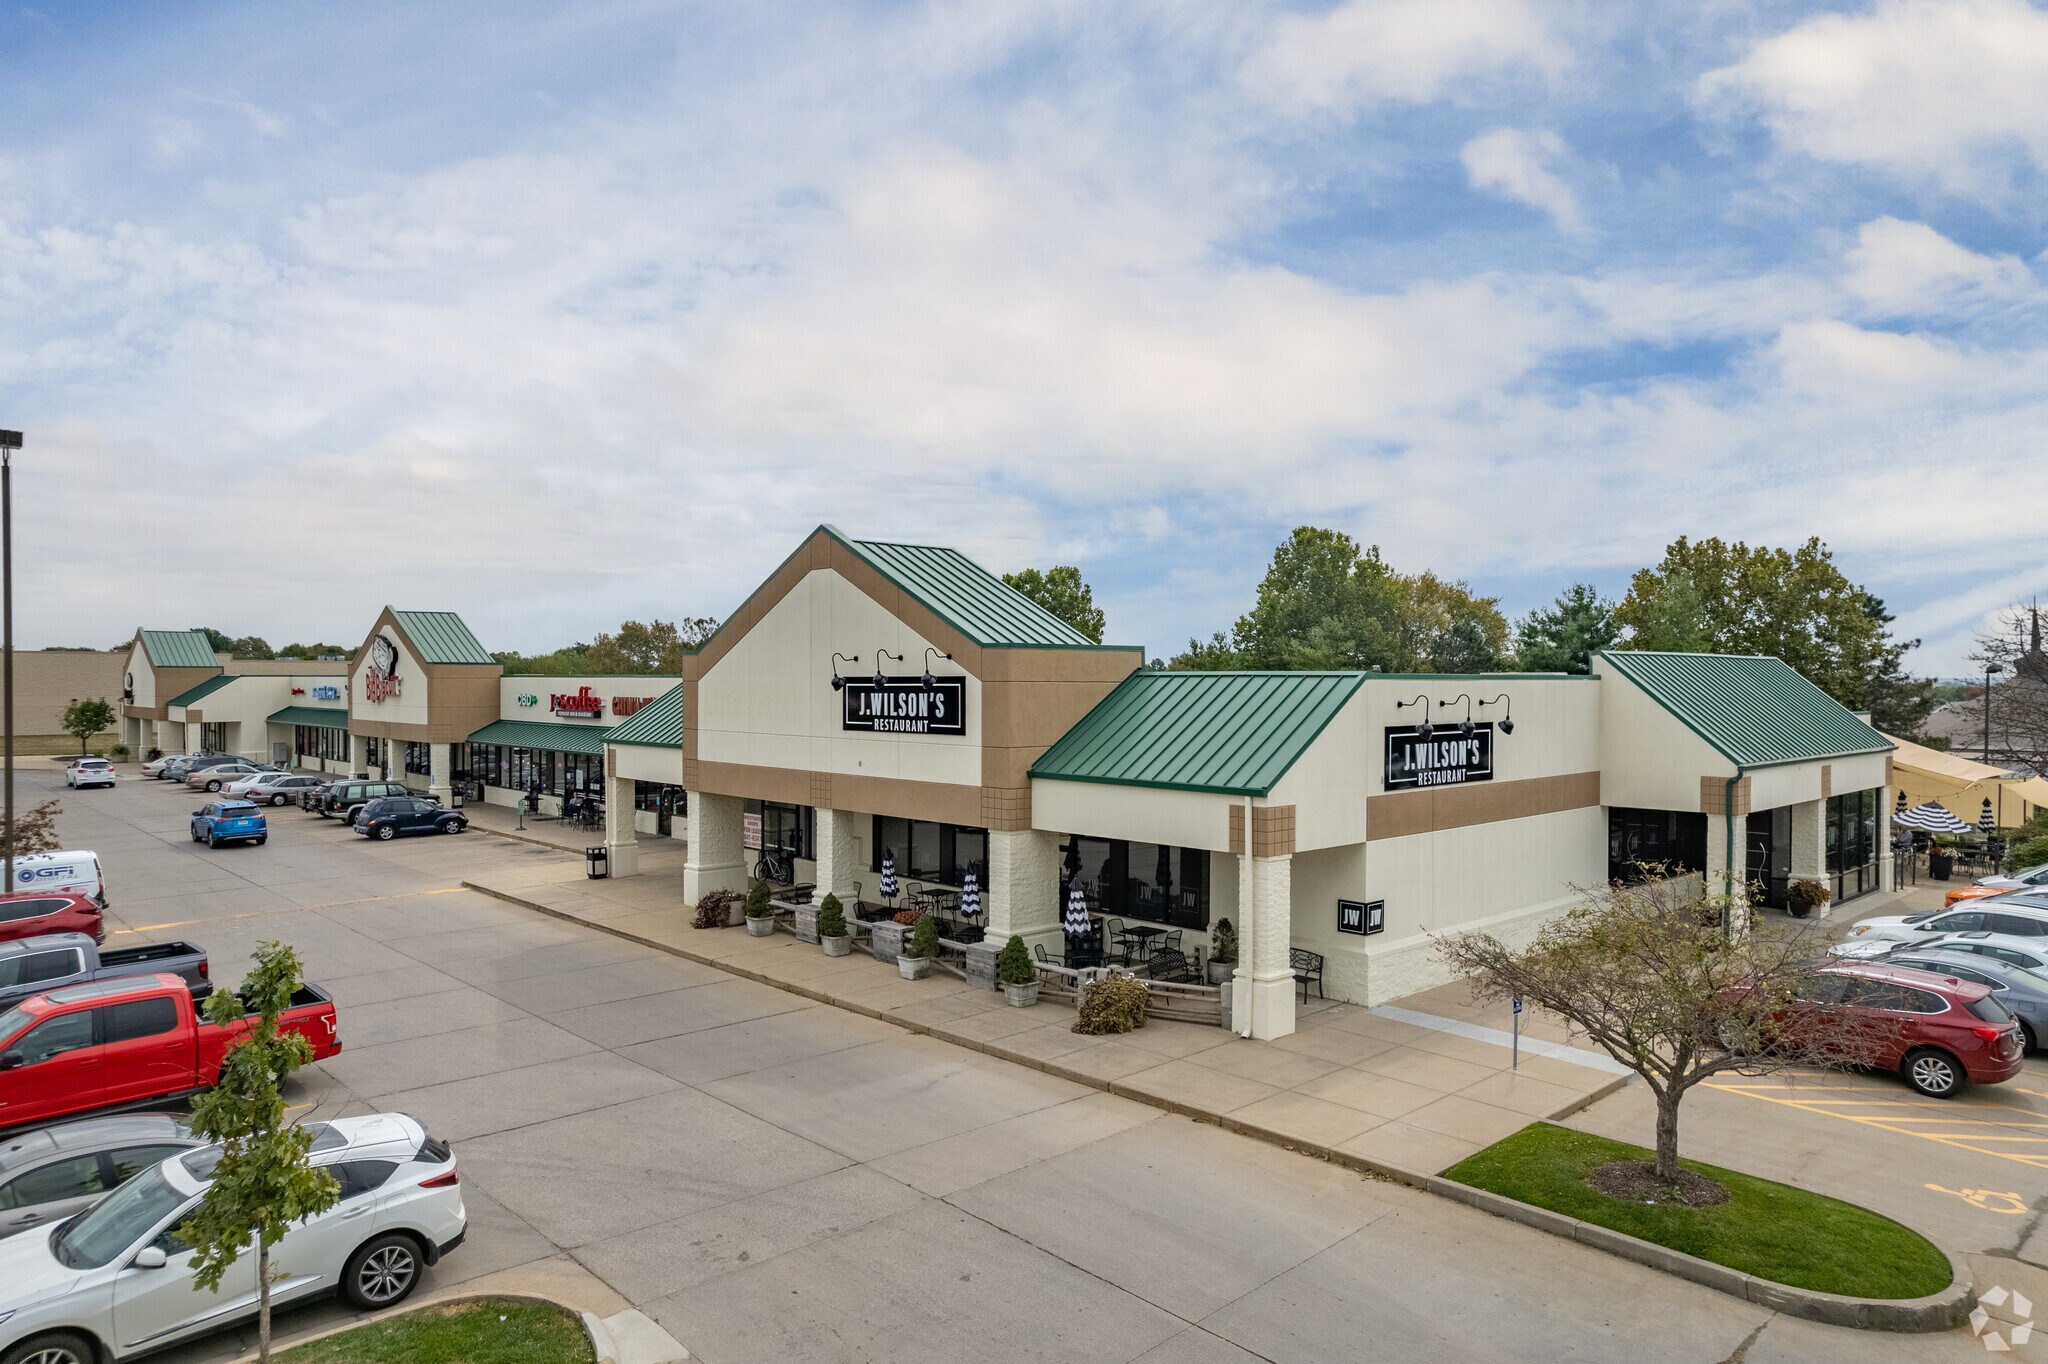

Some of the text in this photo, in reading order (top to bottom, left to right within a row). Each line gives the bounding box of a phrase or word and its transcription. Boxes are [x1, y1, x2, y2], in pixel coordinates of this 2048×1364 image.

[517, 693, 532, 707] CBD
[859, 692, 945, 718] J.WILSON'S
[874, 718, 929, 732] RESTAURANT
[1404, 739, 1479, 770] J.WILSON'S
[1418, 769, 1466, 785] RESTAURANT
[1140, 886, 1152, 900] JW
[1182, 892, 1196, 907] JW
[1343, 908, 1360, 926] JW
[1370, 908, 1382, 927] JW
